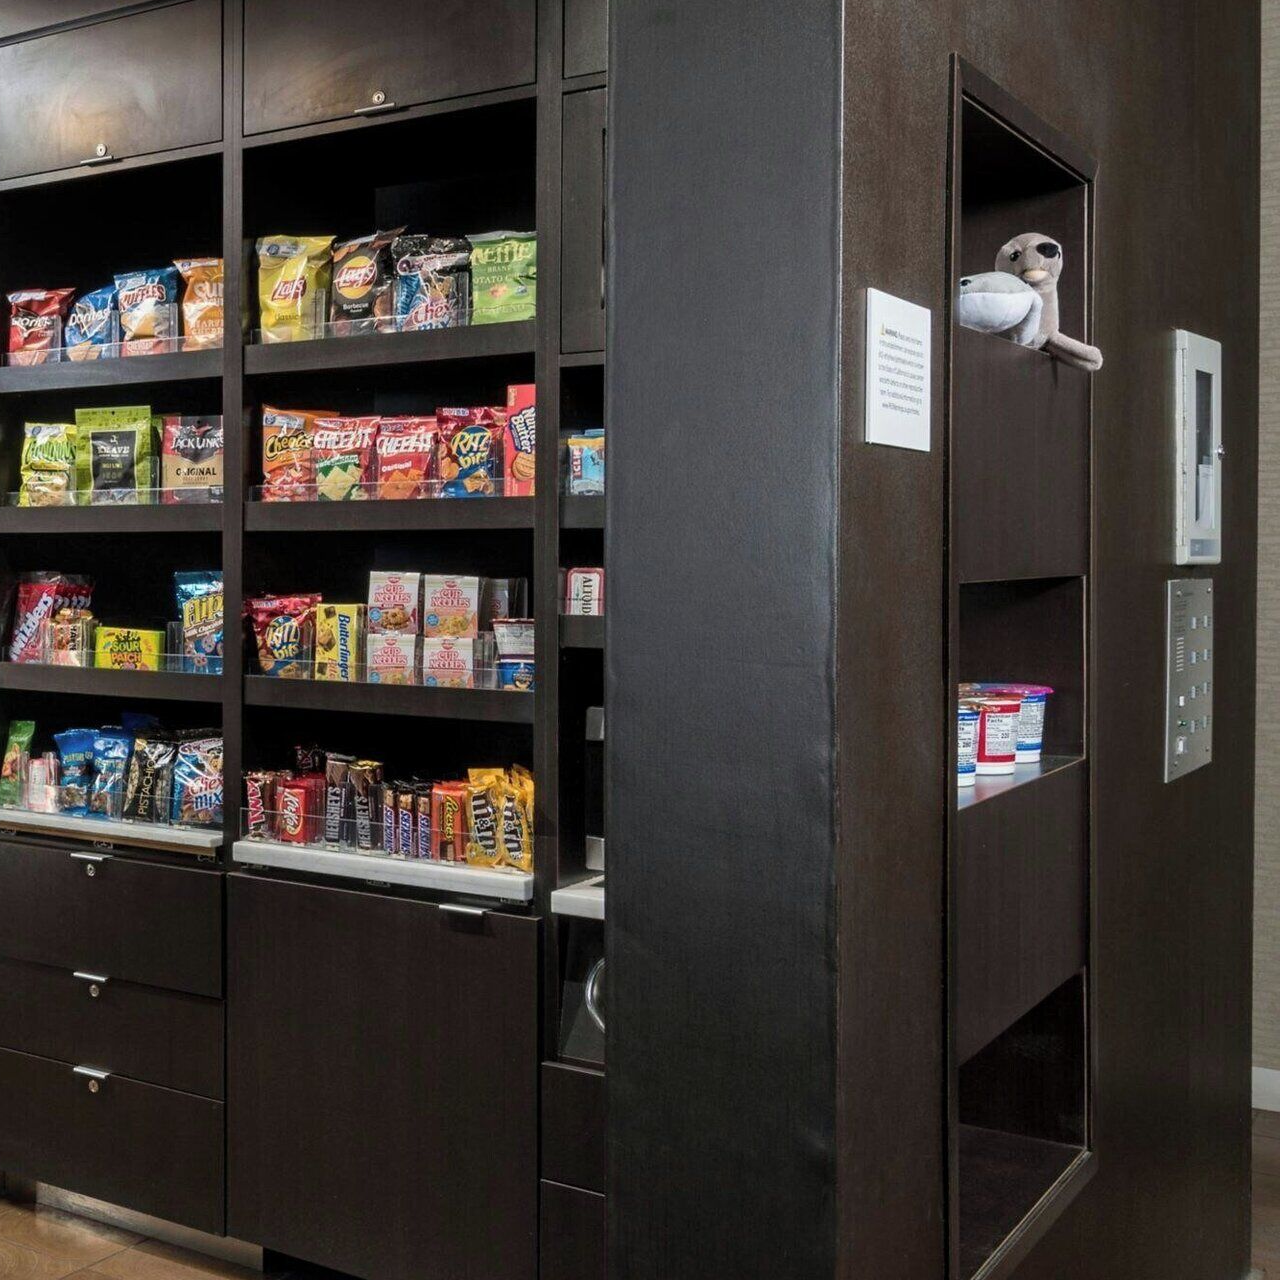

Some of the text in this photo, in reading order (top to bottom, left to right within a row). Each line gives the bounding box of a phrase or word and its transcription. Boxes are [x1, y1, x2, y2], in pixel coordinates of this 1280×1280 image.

[337, 265, 376, 289] Lay's
[472, 277, 504, 285] OTATO
[119, 283, 166, 313] RUFFLES
[275, 277, 306, 300] Lay's
[343, 302, 369, 311] Barbecue
[413, 302, 451, 326] Chex
[68, 308, 112, 327] Doritos
[170, 437, 195, 449] JACK
[451, 431, 491, 456] RITZ
[511, 414, 532, 454] Butter
[374, 592, 412, 603] NOODLES
[383, 584, 405, 594] CUP
[440, 588, 464, 598] CUP
[581, 576, 593, 615] ALTOID
[430, 597, 471, 608] NOODLES
[112, 641, 141, 652] SOUR
[338, 613, 351, 680] Butterfinger
[380, 646, 402, 656] CUP
[436, 651, 459, 661] CUP
[111, 652, 142, 663] PATCH
[371, 654, 408, 665] NOODLES
[429, 660, 467, 670] NOODLES
[194, 790, 224, 811] mix
[325, 787, 341, 840] HERSHEY'S
[355, 795, 371, 849] HERSHEY'S
[444, 795, 459, 842] Reese's
[384, 806, 395, 855] SNICKERS
[400, 810, 412, 856] SNICKERS
